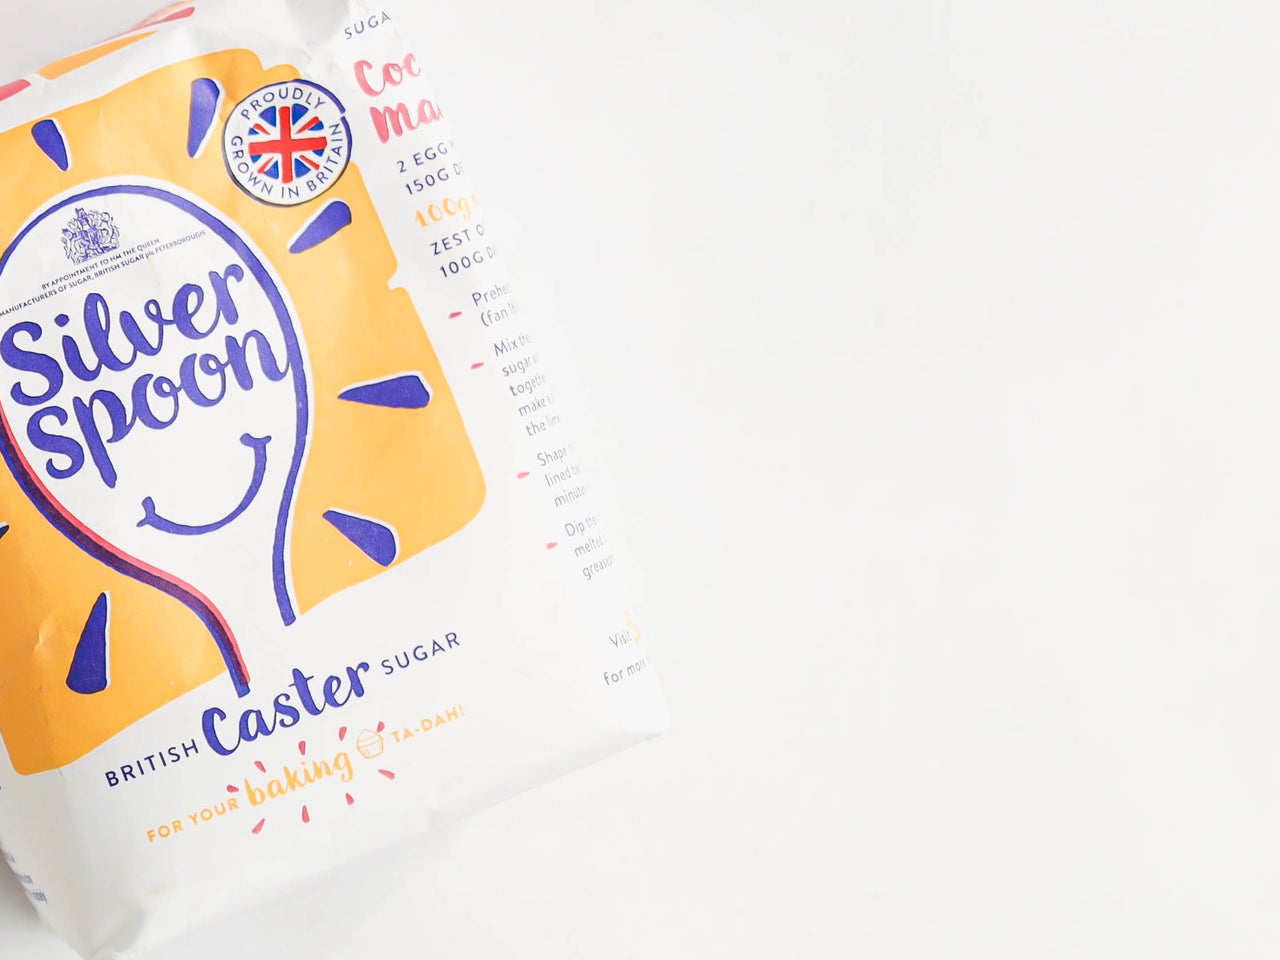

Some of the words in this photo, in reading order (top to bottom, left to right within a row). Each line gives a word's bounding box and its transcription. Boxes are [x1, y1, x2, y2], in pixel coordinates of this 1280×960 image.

[241, 87, 325, 120] PROUDLY
[230, 136, 273, 195] GROWN
[281, 186, 300, 199] IN
[306, 123, 343, 192] BRITAIN
[396, 160, 407, 174] 2
[413, 140, 454, 166] EGG
[405, 168, 450, 196] 150G
[415, 196, 472, 228] 100g
[430, 228, 472, 256] ZEST
[41, 281, 50, 290] BY
[51, 262, 102, 287] APPOINTMENT
[100, 258, 109, 267] TO
[110, 253, 122, 263] HM
[122, 247, 136, 258] THE
[137, 238, 160, 252] QUEEN
[58, 284, 68, 293] OF
[94, 263, 120, 278] BRITISH
[121, 253, 145, 268] SUGAR
[155, 229, 207, 255] PETERBOROUGH
[439, 250, 484, 278] 100G
[480, 307, 509, 327] (fan
[0, 263, 245, 407] Silver
[493, 337, 519, 357] Mix
[502, 355, 532, 377] sugar
[525, 420, 546, 437] the
[537, 447, 567, 467] Shape
[544, 467, 571, 487] lined
[564, 519, 586, 538] Dip
[603, 669, 623, 686] for
[104, 738, 200, 788] BRITISH
[201, 661, 370, 757] Caster
[381, 631, 461, 676] SUGAR
[146, 820, 184, 844] FOR
[187, 797, 241, 827] YOUR
[243, 750, 354, 808] baking
[390, 704, 466, 745] TA-DAH!
